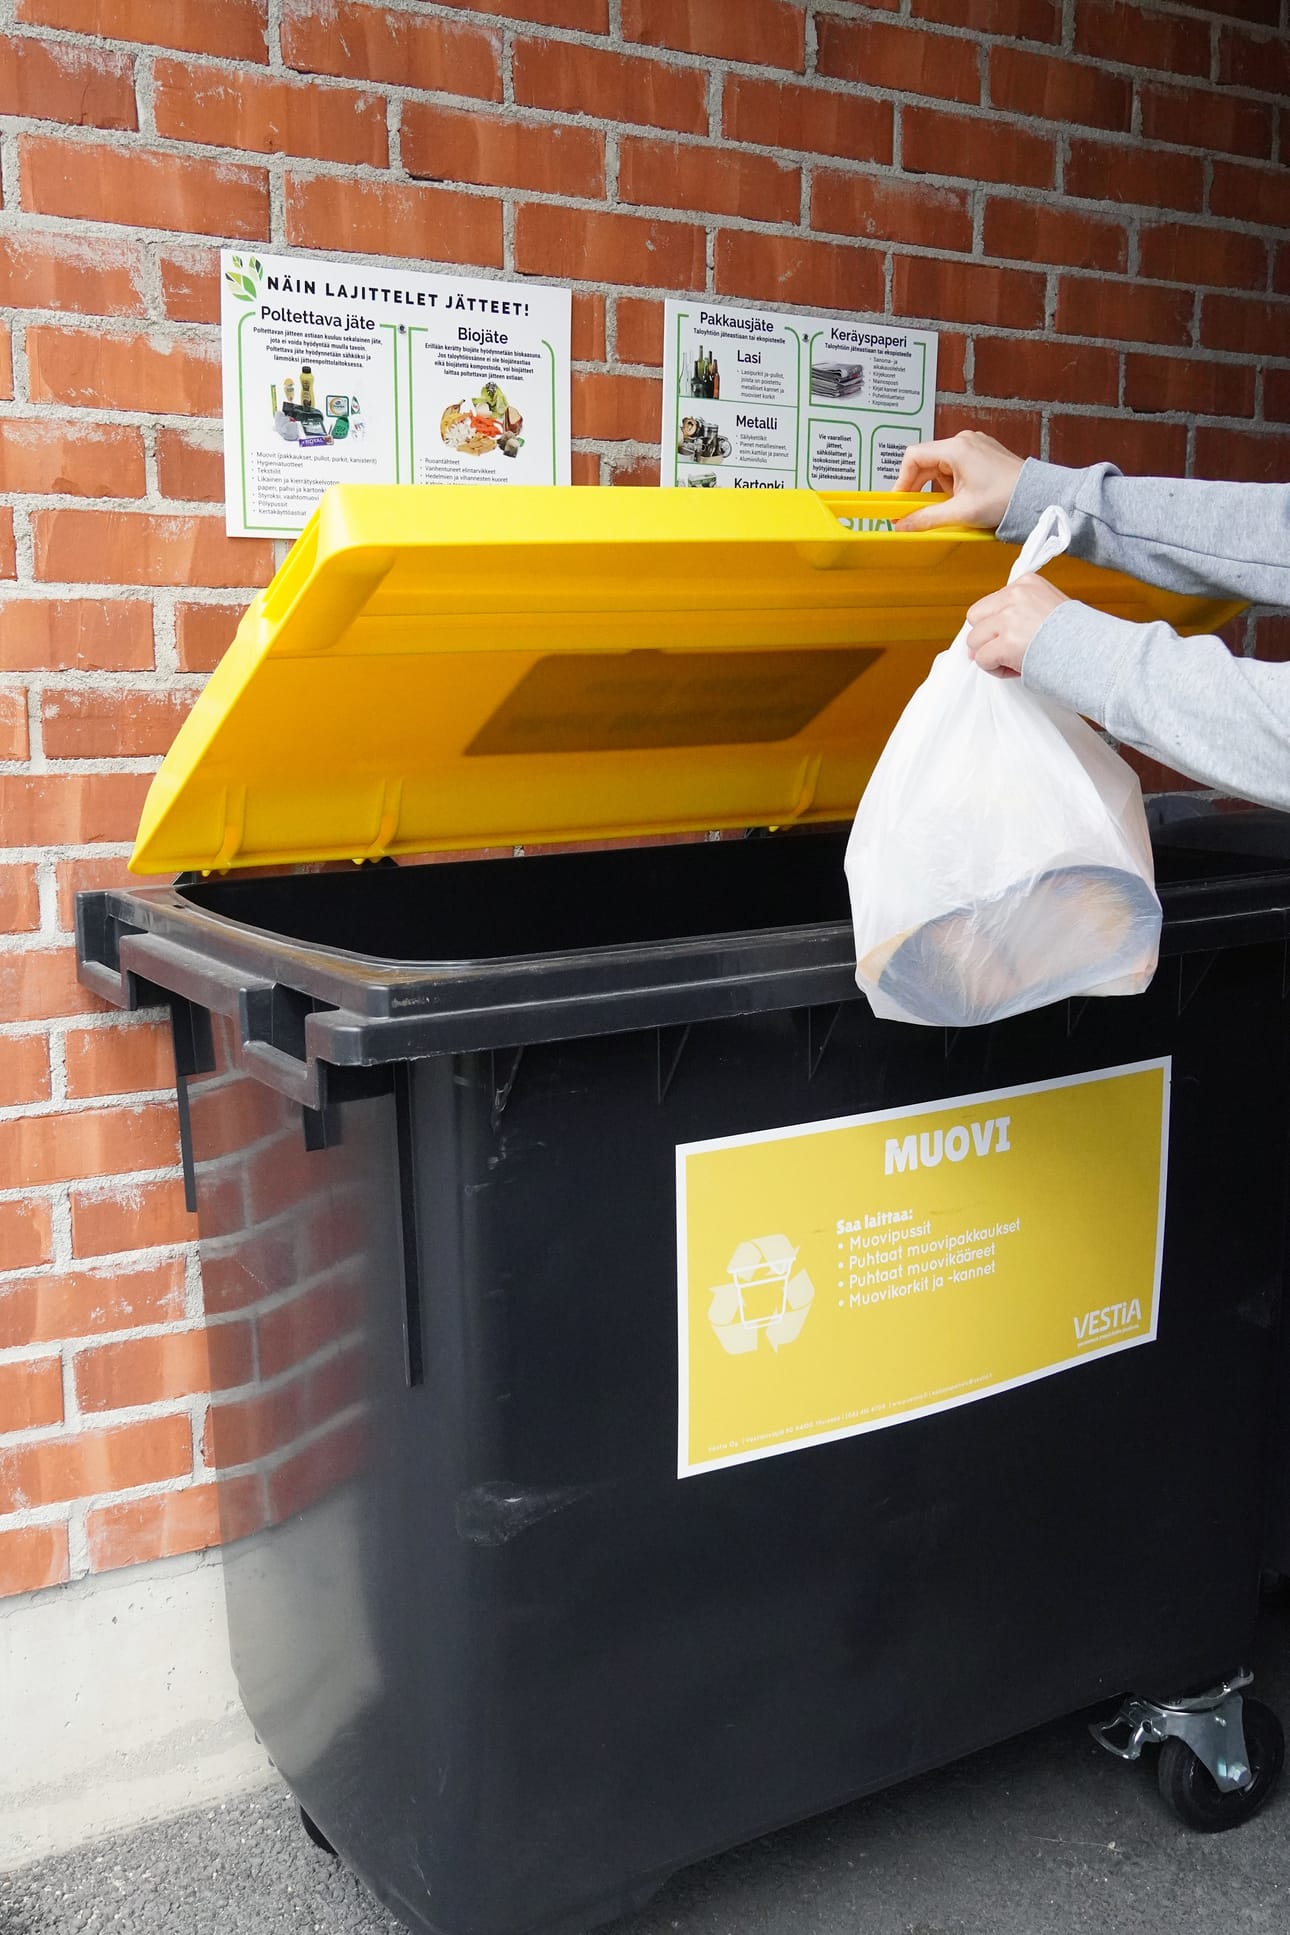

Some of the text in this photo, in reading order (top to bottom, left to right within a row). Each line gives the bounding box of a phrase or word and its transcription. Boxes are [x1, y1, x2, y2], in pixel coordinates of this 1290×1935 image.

[267, 274, 529, 317] NÄIN LAJITTELET JÄTTEET!
[261, 306, 376, 332] Poltettava jäte
[700, 312, 774, 332] Pakkausjäte
[253, 326, 383, 346] Poltettavan jätteen astiaan kuuluu sekalainen jäte,
[458, 327, 509, 345] Biojäte
[694, 328, 720, 337] Taloyhtiön
[831, 328, 907, 348] Keräyspaperi
[266, 345, 293, 354] Poltettava
[294, 347, 305, 355] jäte
[305, 348, 342, 358] hyödynnetään
[342, 351, 364, 360] sähköksi
[303, 340, 330, 349] hyödyntää
[331, 341, 348, 350] muulla
[425, 342, 444, 350] Erillään
[445, 344, 462, 352] kerätty
[462, 346, 480, 354] biojäte
[480, 347, 513, 356] hyödynnetään
[825, 343, 849, 351] Taloyhtiön
[274, 354, 299, 363] lämmöksi
[737, 350, 761, 364] Lasi
[446, 360, 469, 369] biojätettä
[511, 366, 534, 374] biojätteet
[460, 370, 487, 378] poltettavan
[488, 372, 505, 380] jätteen
[736, 415, 778, 430] Metalli
[279, 485, 295, 493] pahvi
[735, 478, 784, 488] Kartonki
[884, 1116, 1011, 1175] MUOVI
[836, 1208, 913, 1235] Saa laittaa:
[849, 1220, 931, 1251] Muovipussit
[849, 1217, 1021, 1270] Puhtaat muovipakkaukset
[849, 1242, 996, 1289] Puhtaat muovikääreet
[849, 1260, 996, 1308] Muovikorkit ja -kannet
